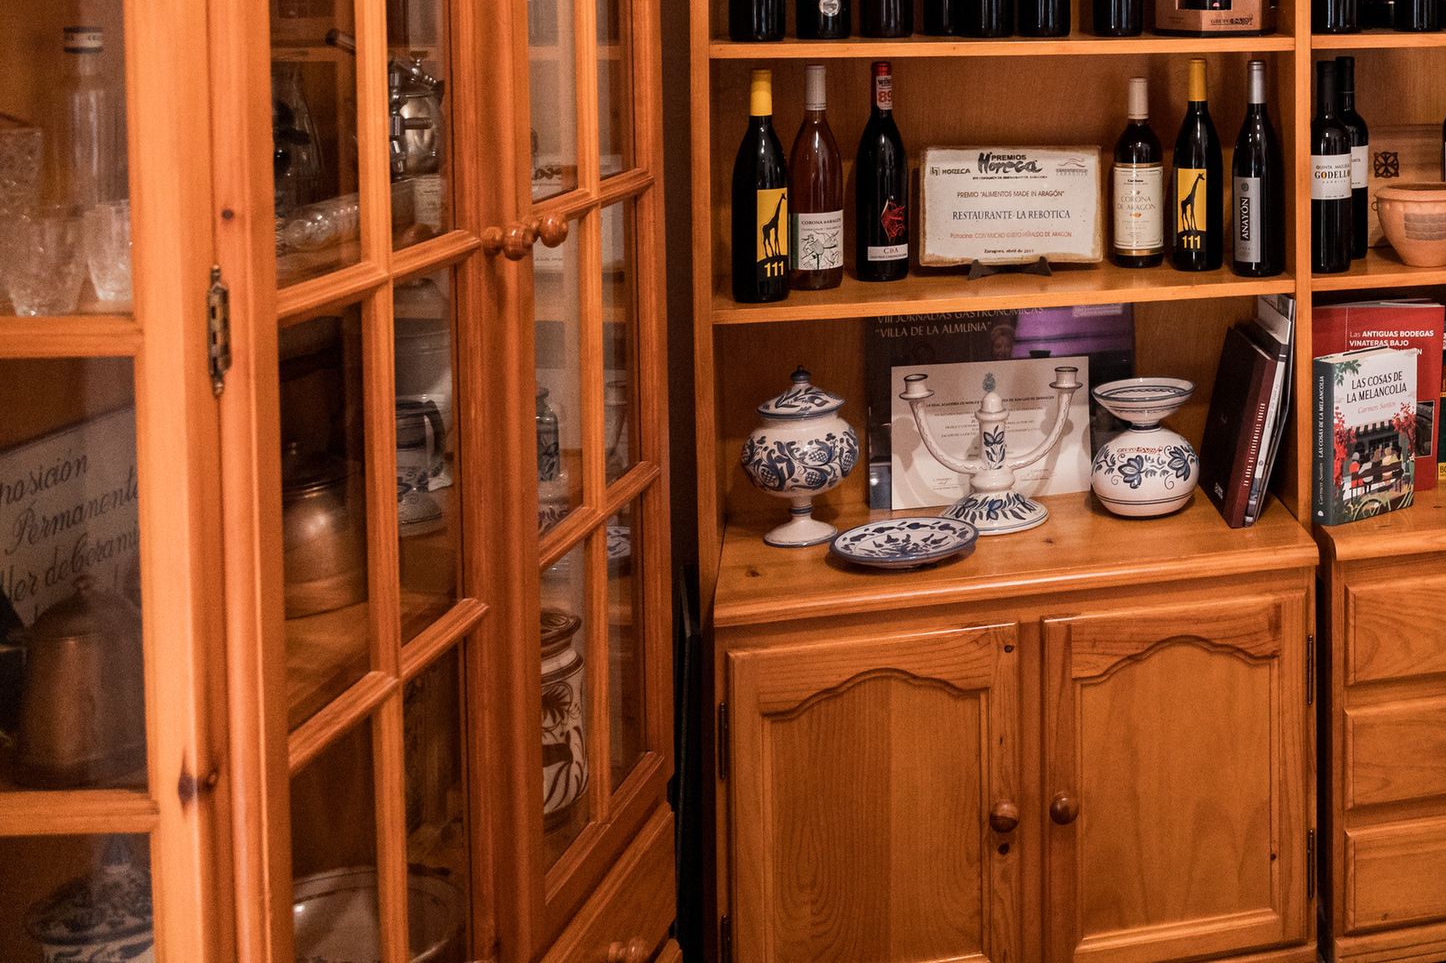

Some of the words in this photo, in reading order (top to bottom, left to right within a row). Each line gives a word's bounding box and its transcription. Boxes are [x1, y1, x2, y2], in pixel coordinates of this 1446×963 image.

[952, 210, 1012, 220] RESTAURANTE
[1016, 210, 1028, 219] LA
[1028, 209, 1072, 219] REBOTICA
[1241, 197, 1249, 240] ANAYÓN
[1182, 235, 1201, 249] 111
[764, 262, 784, 277] 111
[911, 327, 924, 336] DE
[926, 326, 940, 335] LA
[1362, 330, 1399, 338] ANTIGUAS
[1400, 329, 1435, 338] BODEGAS
[1350, 339, 1389, 347] VINATERAS
[1389, 339, 1409, 347] BAJO
[1351, 378, 1366, 390] LAS
[1367, 374, 1392, 387] COSAS
[1393, 371, 1403, 382] DE
[1346, 393, 1357, 404] LA
[1358, 382, 1407, 402] MELANCOLÍA
